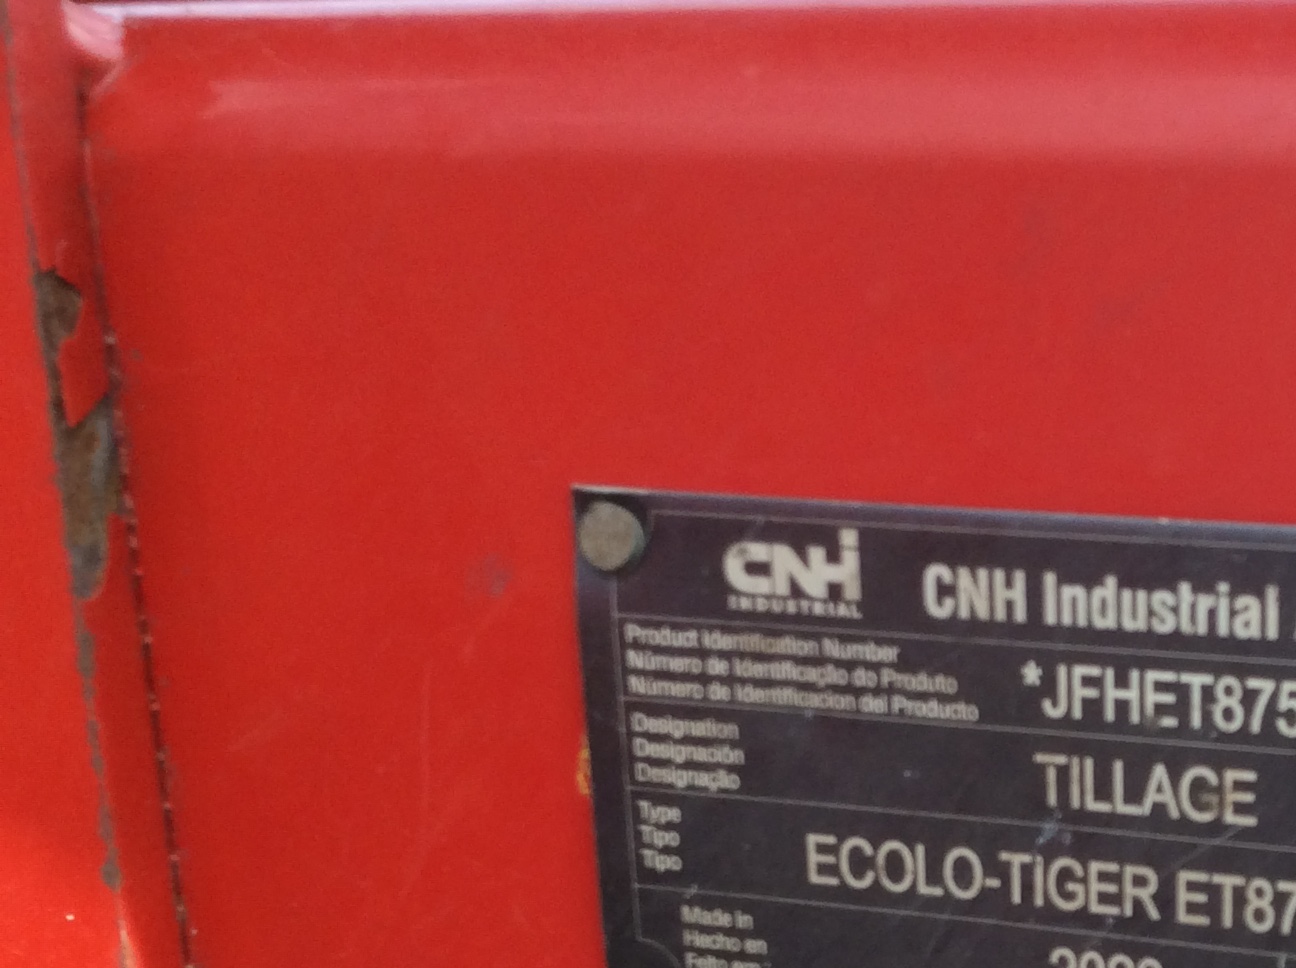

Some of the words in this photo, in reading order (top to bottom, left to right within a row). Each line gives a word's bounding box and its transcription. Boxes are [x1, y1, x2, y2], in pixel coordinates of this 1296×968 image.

[723, 528, 862, 600] CNH
[922, 561, 1028, 624] CNH
[1042, 568, 1280, 642] Industrial
[624, 622, 699, 648] Product
[701, 628, 819, 657] Identification
[821, 636, 900, 664] Number
[703, 656, 731, 677] de
[879, 666, 959, 695] Produto
[706, 681, 732, 701] de
[890, 694, 980, 722] Producto
[630, 711, 740, 740] Designation
[1032, 751, 1259, 828] TILLAGE
[636, 799, 682, 825] Type
[638, 824, 681, 849] Tipo
[639, 848, 683, 873] Tipo
[804, 833, 1161, 922] ECOLO-TIGER
[680, 903, 733, 929] Made
[733, 909, 755, 930] in
[682, 928, 742, 953] Hecho
